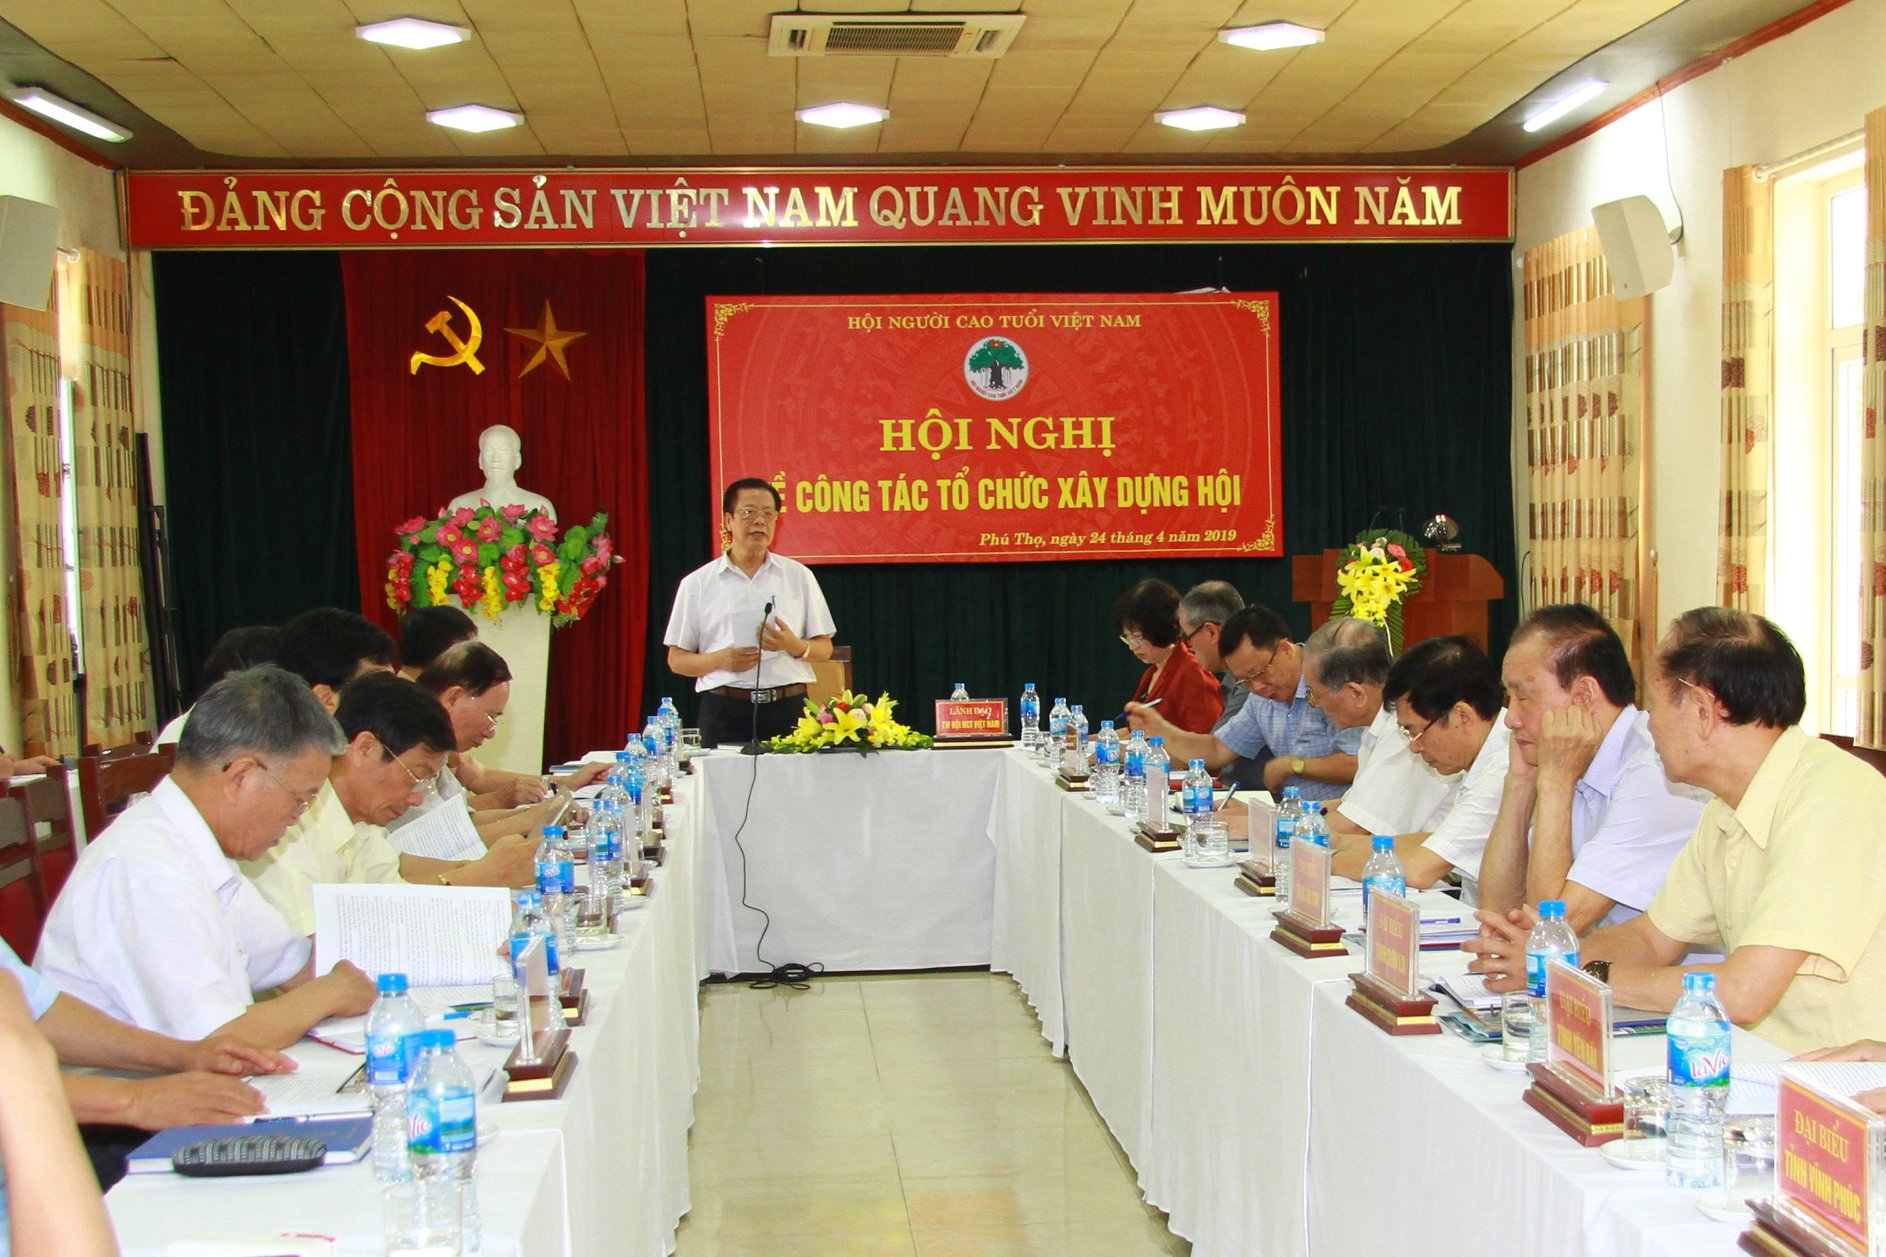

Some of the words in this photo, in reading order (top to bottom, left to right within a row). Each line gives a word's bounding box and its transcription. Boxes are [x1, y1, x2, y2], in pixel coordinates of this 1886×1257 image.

[178, 177, 326, 231] ĐẢNG
[342, 178, 484, 240] CỘNG
[494, 175, 597, 231] SẢN
[610, 178, 728, 239] VIỆT
[742, 186, 858, 229] NAM
[869, 185, 1044, 229] QUANG
[1056, 186, 1182, 226] VINH
[1197, 175, 1341, 226] MUÔN
[1354, 176, 1462, 226] NĂM
[848, 313, 882, 332] HỘI
[888, 312, 950, 329] NGƯỜI
[956, 315, 994, 329] CAO
[999, 309, 1045, 329] TUỔI
[1050, 312, 1094, 331] VIỆT
[1100, 314, 1141, 328] NAM
[879, 408, 973, 460] HỘI
[986, 416, 1116, 457] NGHỊ
[796, 474, 870, 513] CÔNG
[878, 473, 928, 511] TÁC
[936, 466, 970, 511] TỔ
[978, 471, 1049, 510] CHỨC
[1057, 471, 1108, 508] XÂY
[1117, 473, 1189, 514] DỰNG
[1197, 469, 1241, 513] HỘI
[979, 533, 1010, 546] Phú
[1014, 533, 1046, 547] Thọ,
[1050, 533, 1086, 547] ngày
[1089, 532, 1106, 544] 24
[1110, 531, 1152, 547] tháng
[1156, 532, 1165, 543] 4
[1169, 531, 1200, 543] năm
[1204, 530, 1237, 542] 2019
[1795, 1109, 1817, 1147] ĐẠI
[1819, 1120, 1848, 1163] BIỂU
[1784, 1144, 1808, 1188] TỈNH
[1809, 1162, 1832, 1205] VĨNH
[1833, 1179, 1861, 1225] PHÚC
